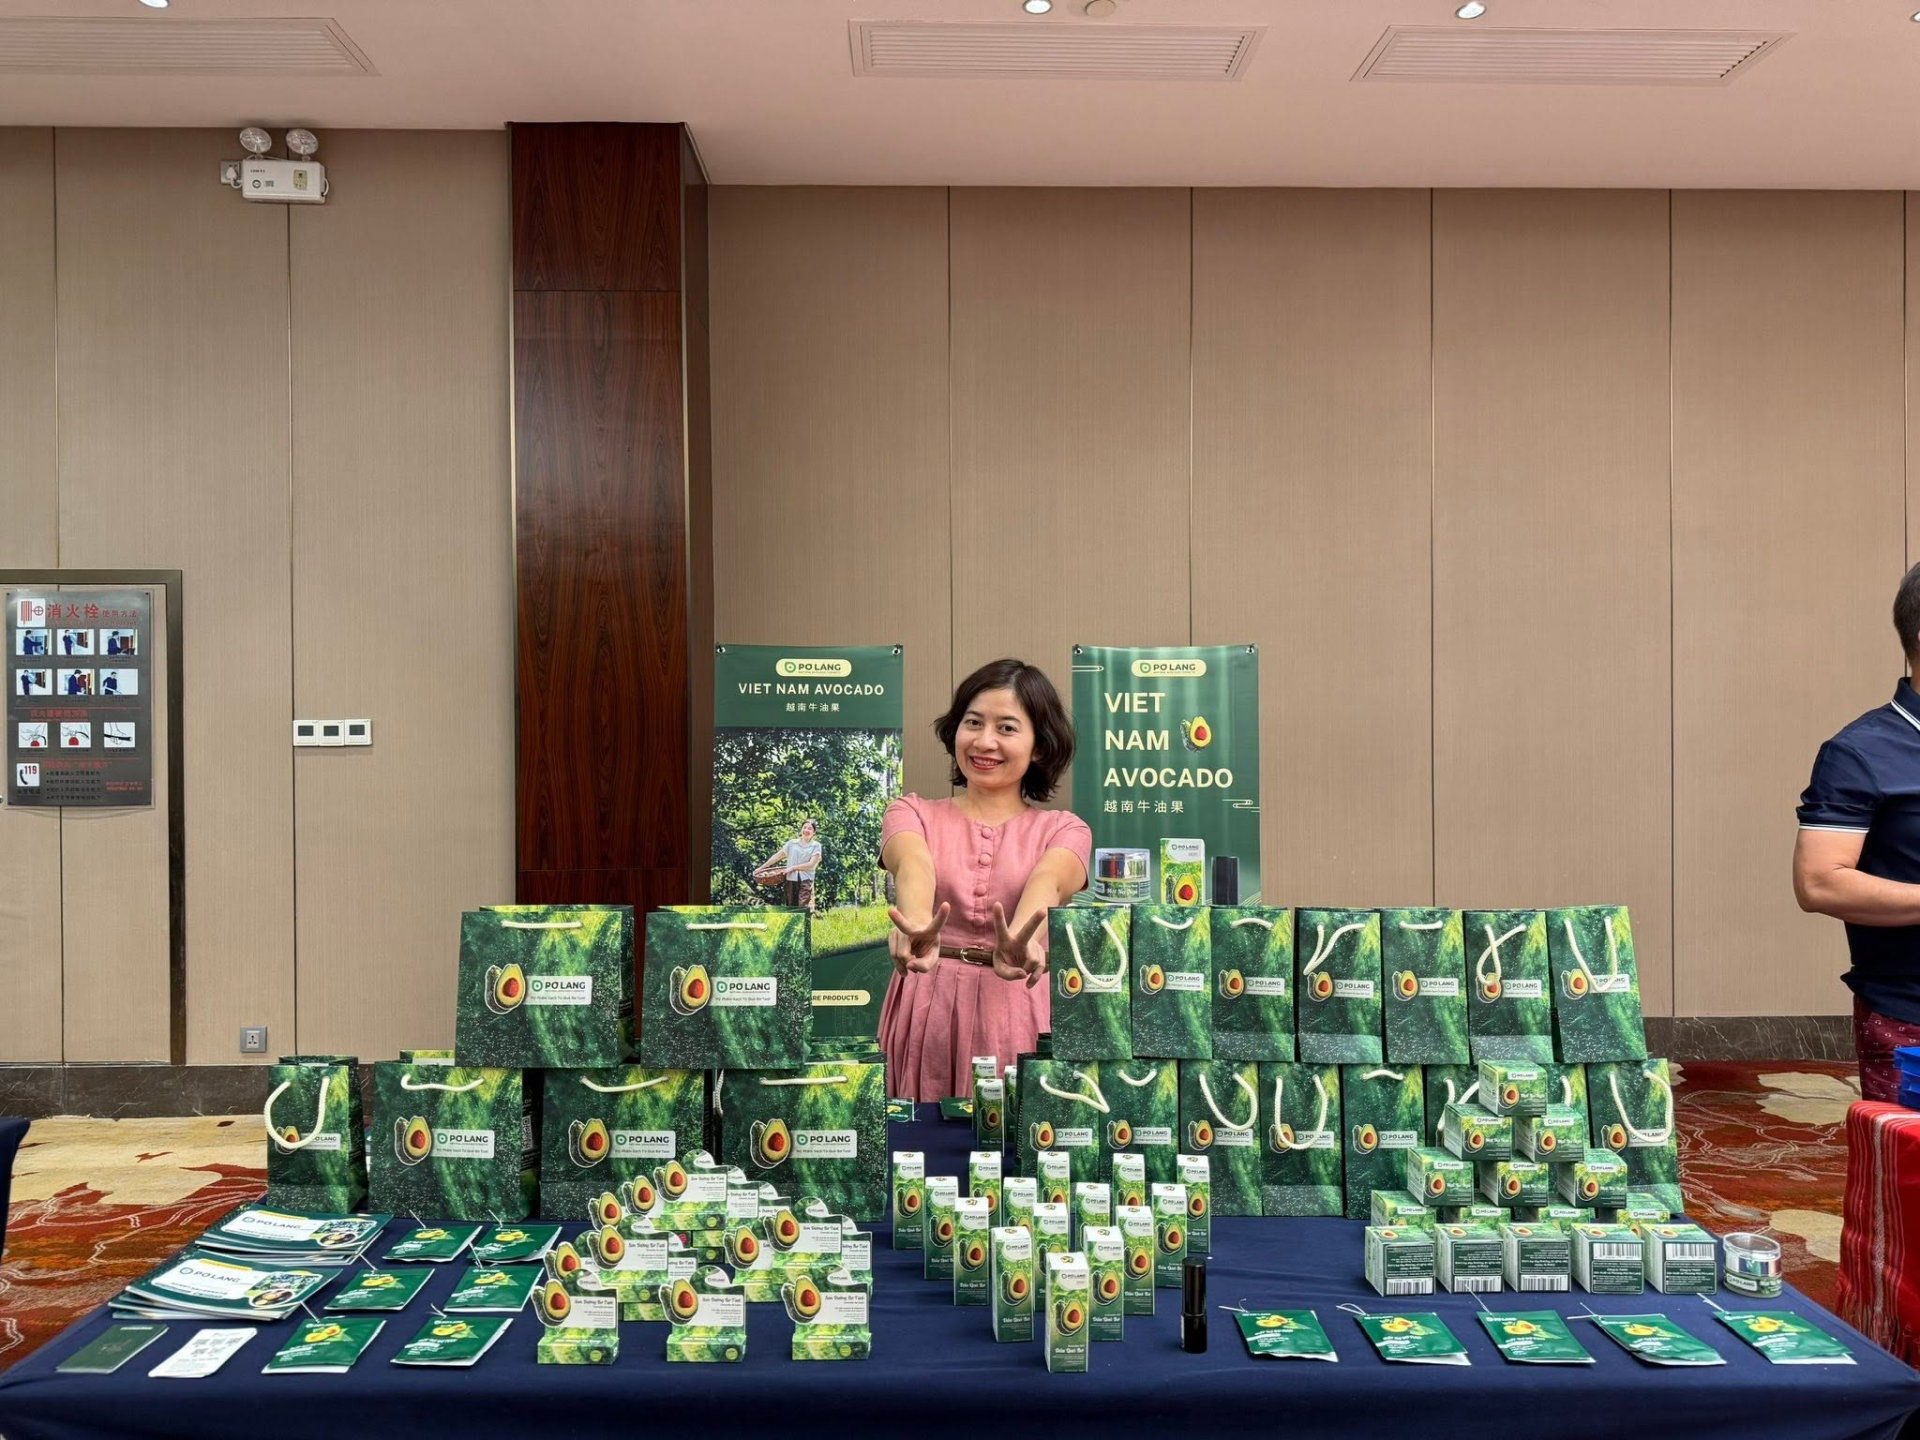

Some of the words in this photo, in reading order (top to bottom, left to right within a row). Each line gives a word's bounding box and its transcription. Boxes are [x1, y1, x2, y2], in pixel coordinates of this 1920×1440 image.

[47, 603, 99, 619] 消火栓
[814, 663, 841, 671] LANG
[1169, 663, 1196, 671] LANG
[738, 683, 772, 695] VIET
[776, 683, 810, 695] NAM
[814, 683, 885, 696] AVOCADO
[785, 702, 840, 713] 越南牛油果
[1104, 692, 1166, 713] VIET
[1105, 729, 1170, 750] NAM
[24, 765, 38, 775] 119
[1103, 767, 1233, 788] AVOCADO
[1104, 800, 1184, 813] 越南牛油果
[560, 981, 586, 990] LANG
[744, 982, 771, 990] LANG
[464, 1135, 489, 1143] LANG
[825, 1135, 851, 1143] LANG
[273, 1221, 302, 1229] LANG
[210, 1271, 241, 1283] LANG
